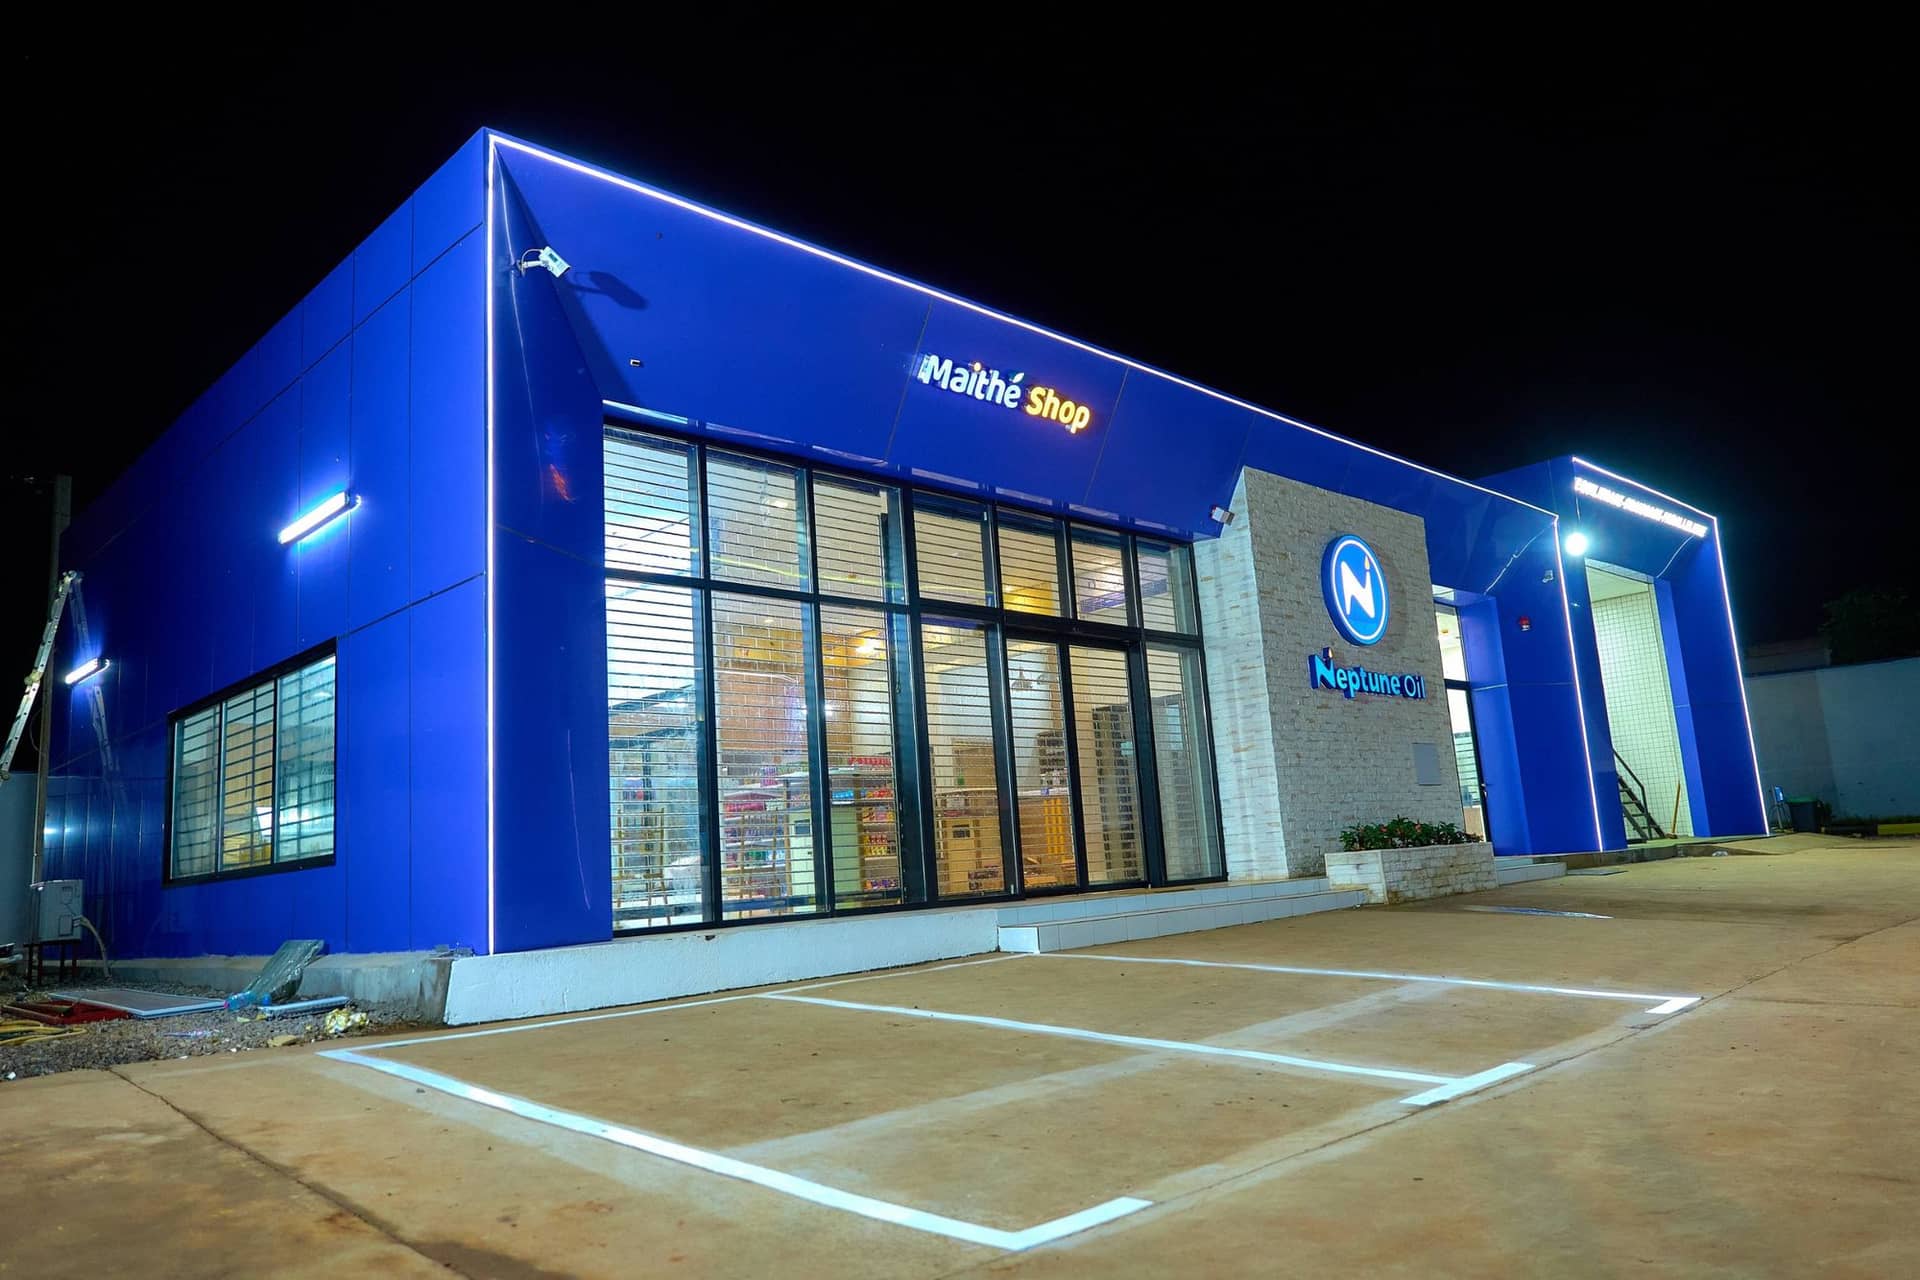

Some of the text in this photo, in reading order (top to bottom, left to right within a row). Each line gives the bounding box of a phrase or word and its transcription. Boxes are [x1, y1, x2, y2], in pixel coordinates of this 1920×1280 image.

[918, 354, 1091, 434] Maithé Shop
[1309, 649, 1427, 698] Neptune Oil
